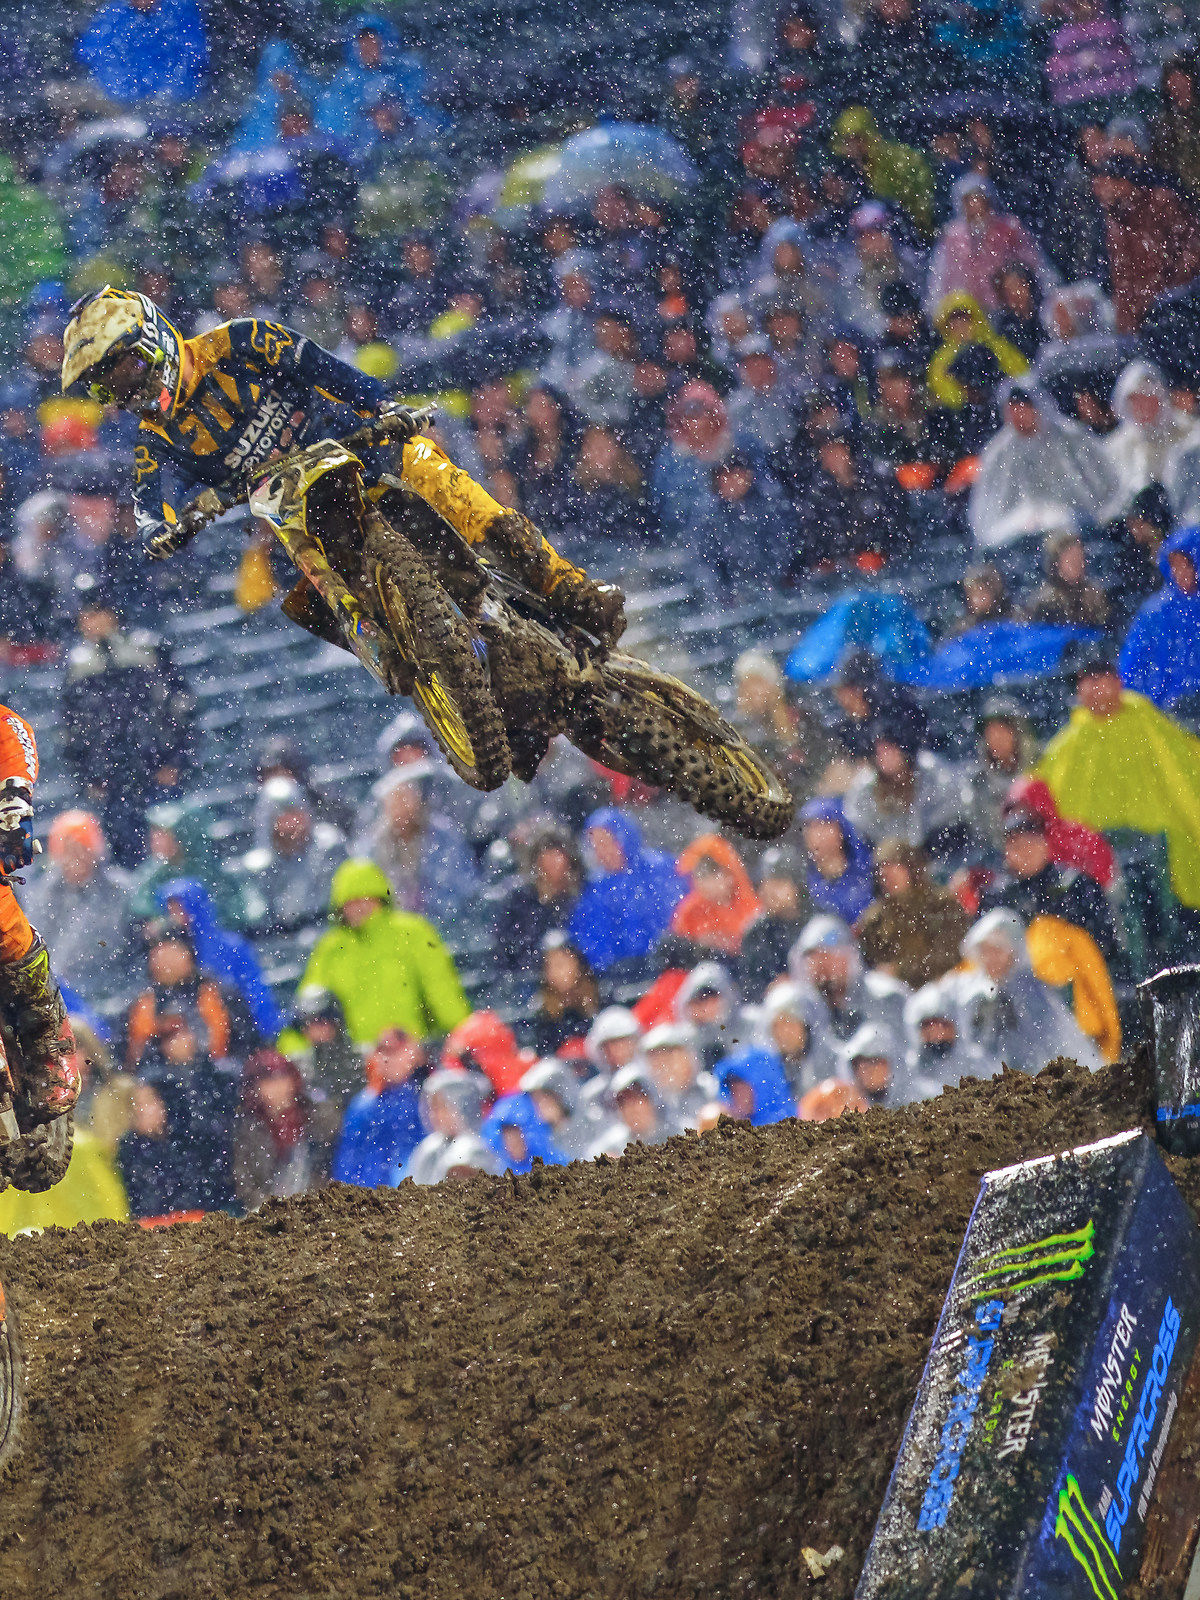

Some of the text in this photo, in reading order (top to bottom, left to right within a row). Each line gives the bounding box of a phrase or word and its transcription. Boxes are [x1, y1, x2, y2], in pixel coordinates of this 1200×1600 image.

[253, 401, 294, 457] TOYOTA
[1105, 1295, 1181, 1555] SUPERCROSS
[1112, 1347, 1142, 1443] ENERGY
